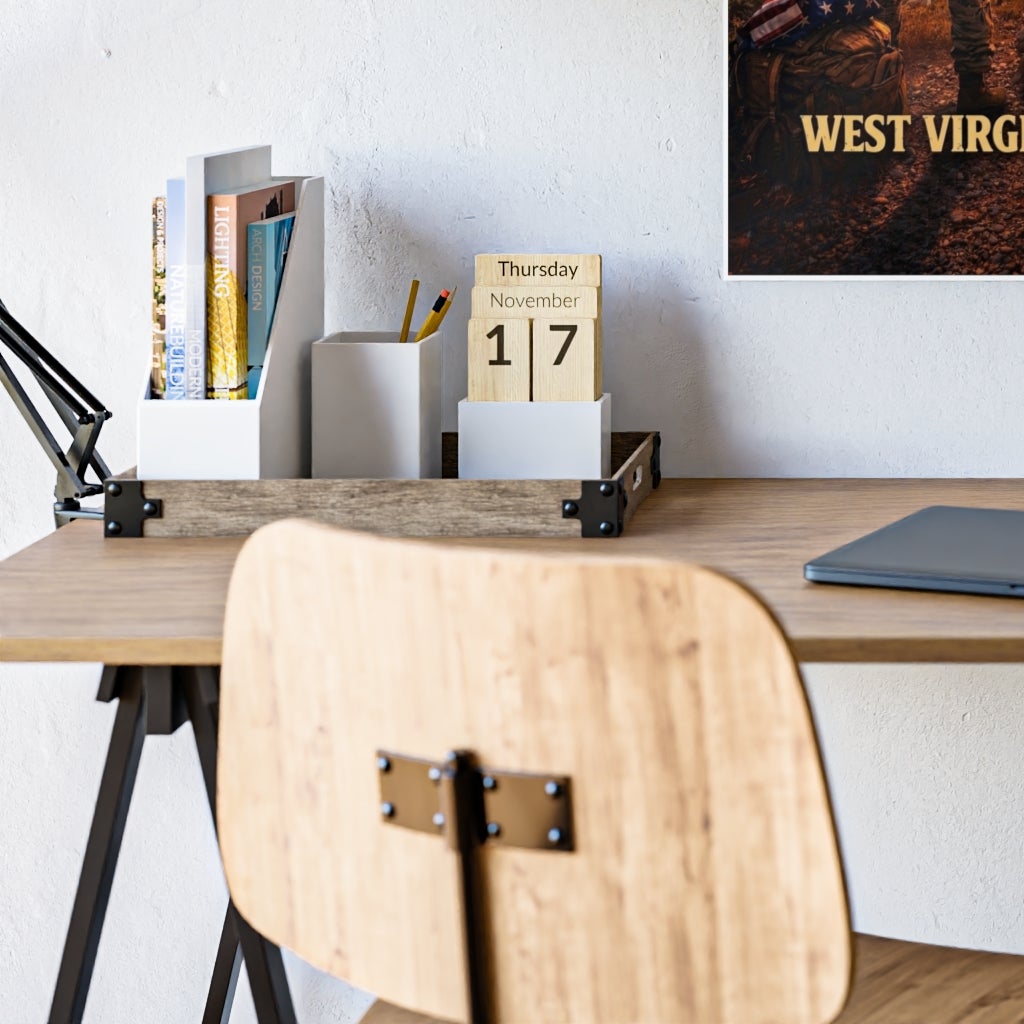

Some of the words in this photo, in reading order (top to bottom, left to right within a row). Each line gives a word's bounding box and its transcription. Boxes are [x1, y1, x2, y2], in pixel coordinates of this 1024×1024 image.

[800, 114, 912, 153] WEST
[156, 200, 165, 229] DESIGN
[213, 205, 230, 299] LIGHTING
[251, 228, 262, 261] ARCH
[498, 260, 578, 280] Thursday
[251, 265, 263, 312] DESIGN
[490, 292, 580, 308] November
[189, 329, 202, 399] MODERN
